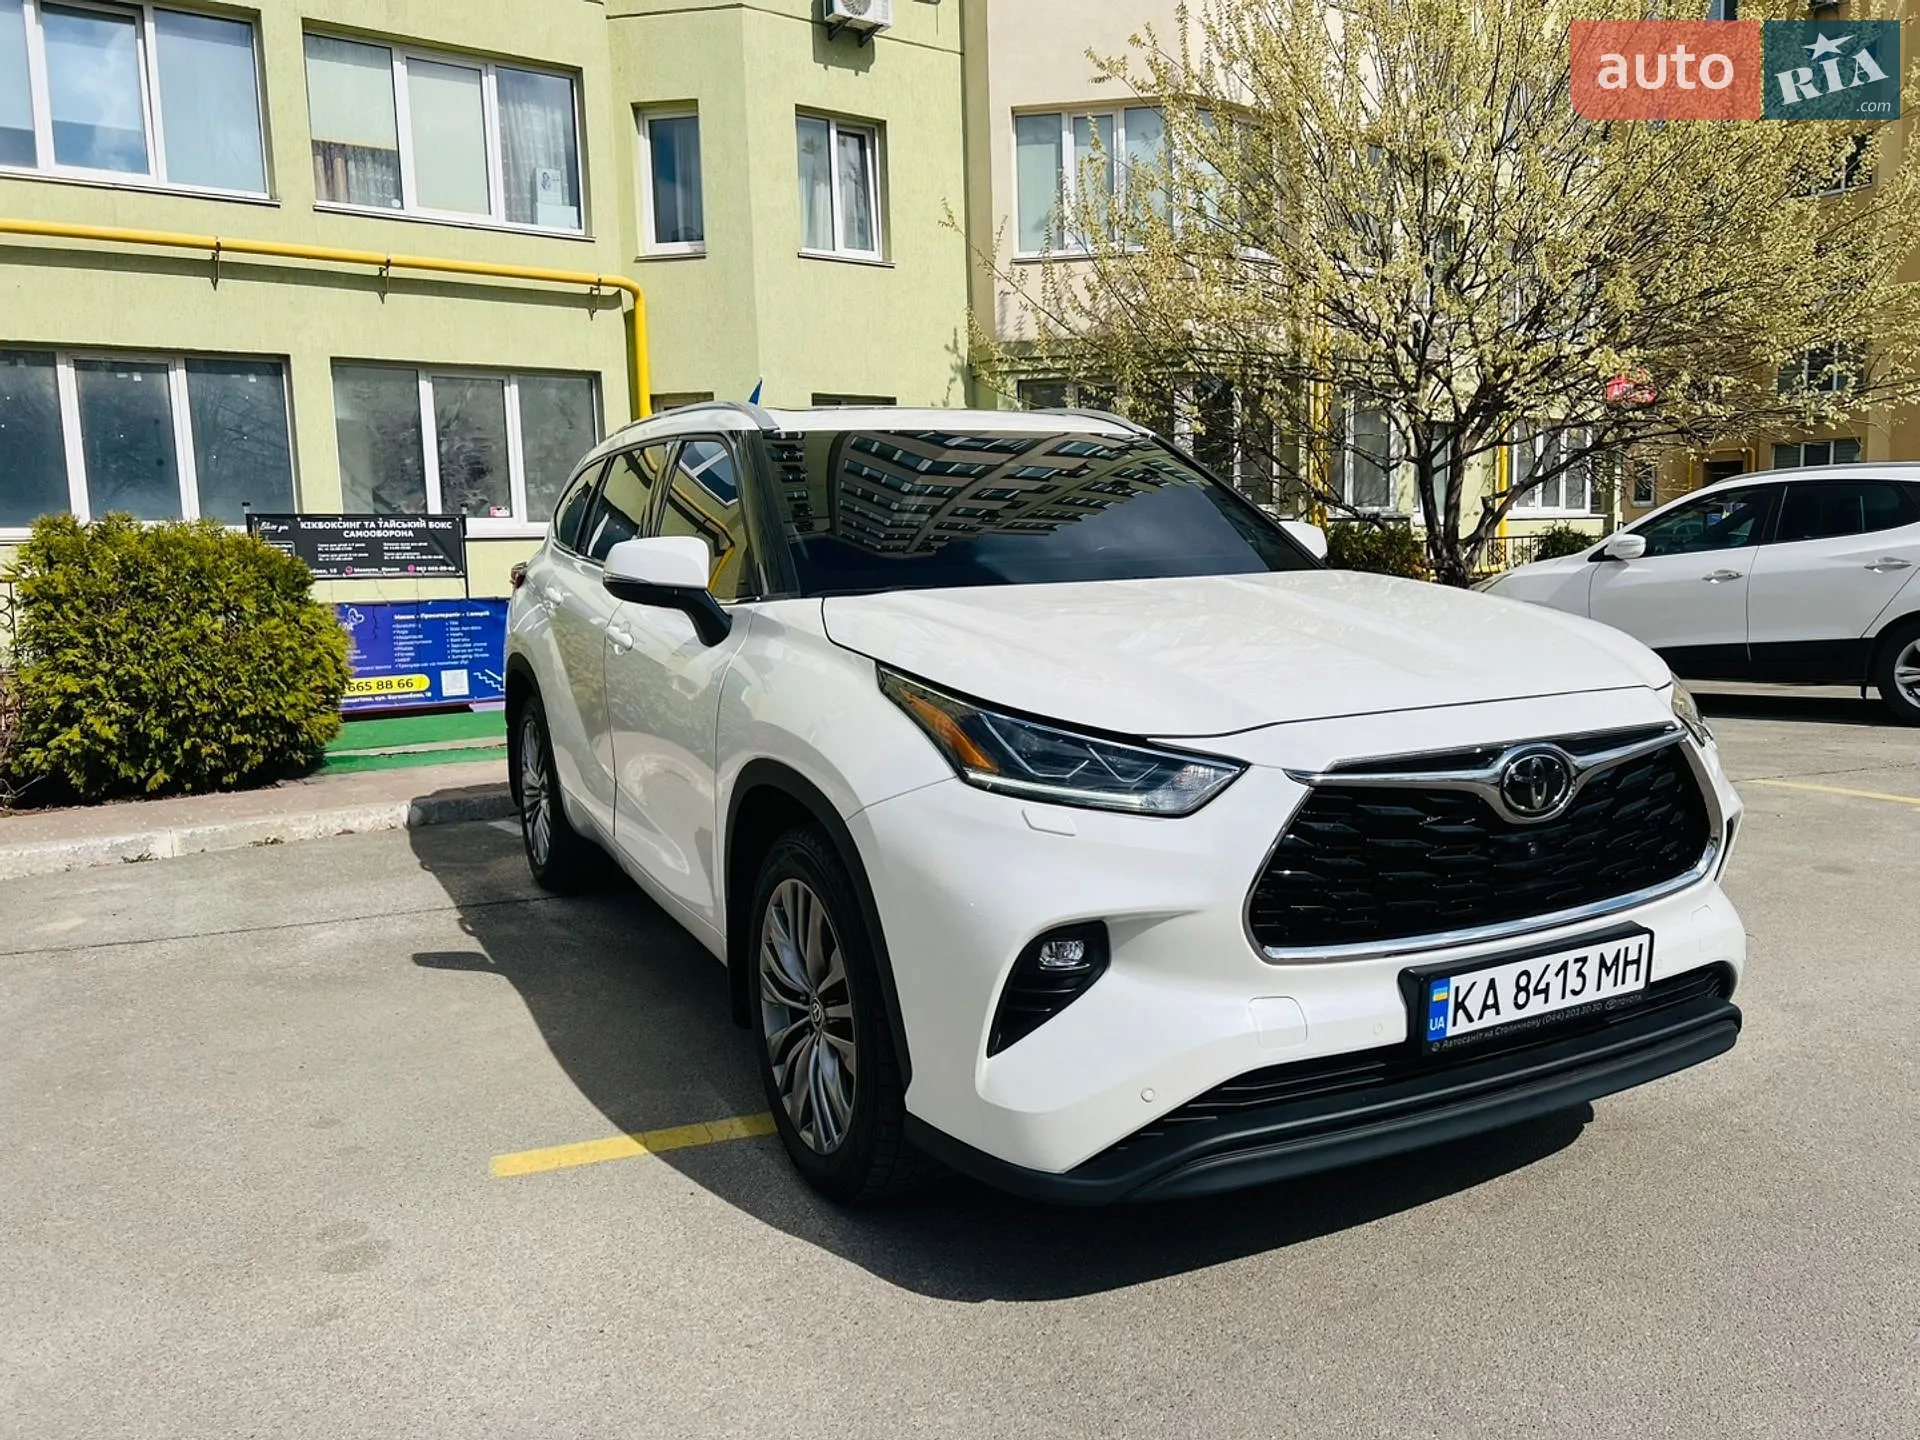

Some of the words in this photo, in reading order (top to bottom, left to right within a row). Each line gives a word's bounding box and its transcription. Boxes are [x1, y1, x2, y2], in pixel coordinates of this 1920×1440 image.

[363, 521, 376, 529] ТА
[378, 519, 427, 529] ТАЙСЬКИЙ
[428, 521, 453, 529] БОКС
[343, 530, 415, 538] САМООБОРОНА
[348, 679, 373, 692] 665
[376, 679, 394, 690] 88
[397, 678, 414, 689] 66
[1452, 977, 1501, 1027] KA
[1513, 955, 1589, 1011] 8413
[1596, 942, 1645, 992] MH
[1429, 1017, 1445, 1032] UA
